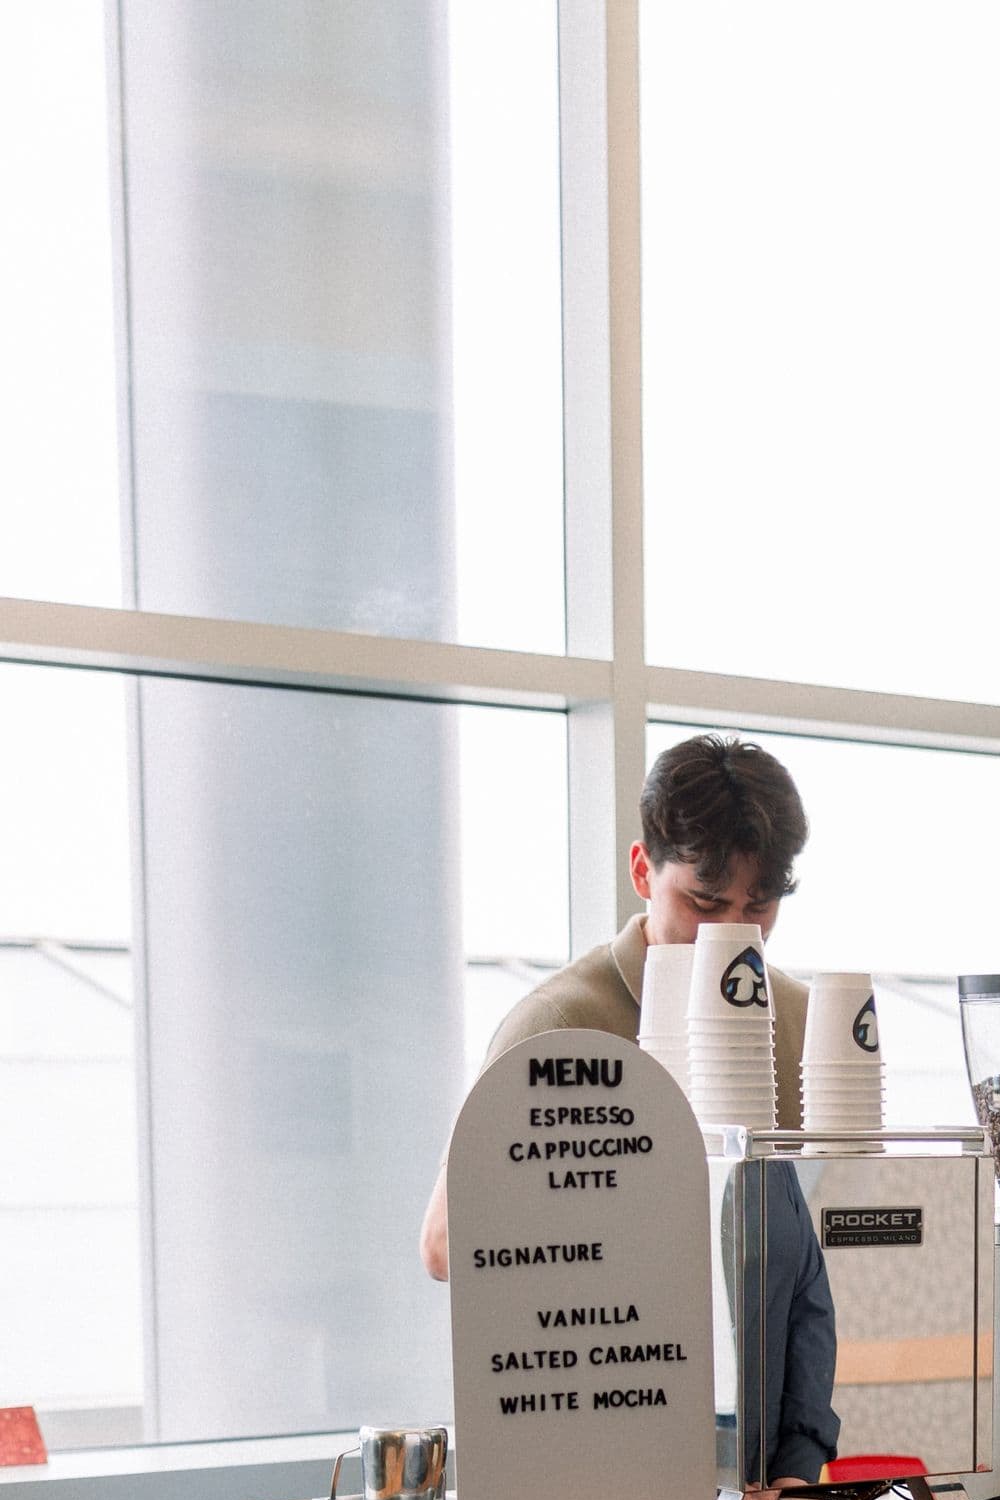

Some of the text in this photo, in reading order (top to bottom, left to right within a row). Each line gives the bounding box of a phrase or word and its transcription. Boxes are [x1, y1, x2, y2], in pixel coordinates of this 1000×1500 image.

[529, 1057, 623, 1088] MENU
[529, 1106, 635, 1127] ESPRESSO
[509, 1135, 653, 1162] CAPPUCCINO
[549, 1170, 618, 1189] LATTE
[831, 1213, 917, 1227] ROCKET
[830, 1234, 917, 1243] ESPRESSO MILANO
[474, 1243, 603, 1268] SIGNATURE
[537, 1305, 640, 1328] VANILLA
[491, 1343, 688, 1373] SALTED CARAMEL
[500, 1388, 668, 1415] WHITE MOCHA
